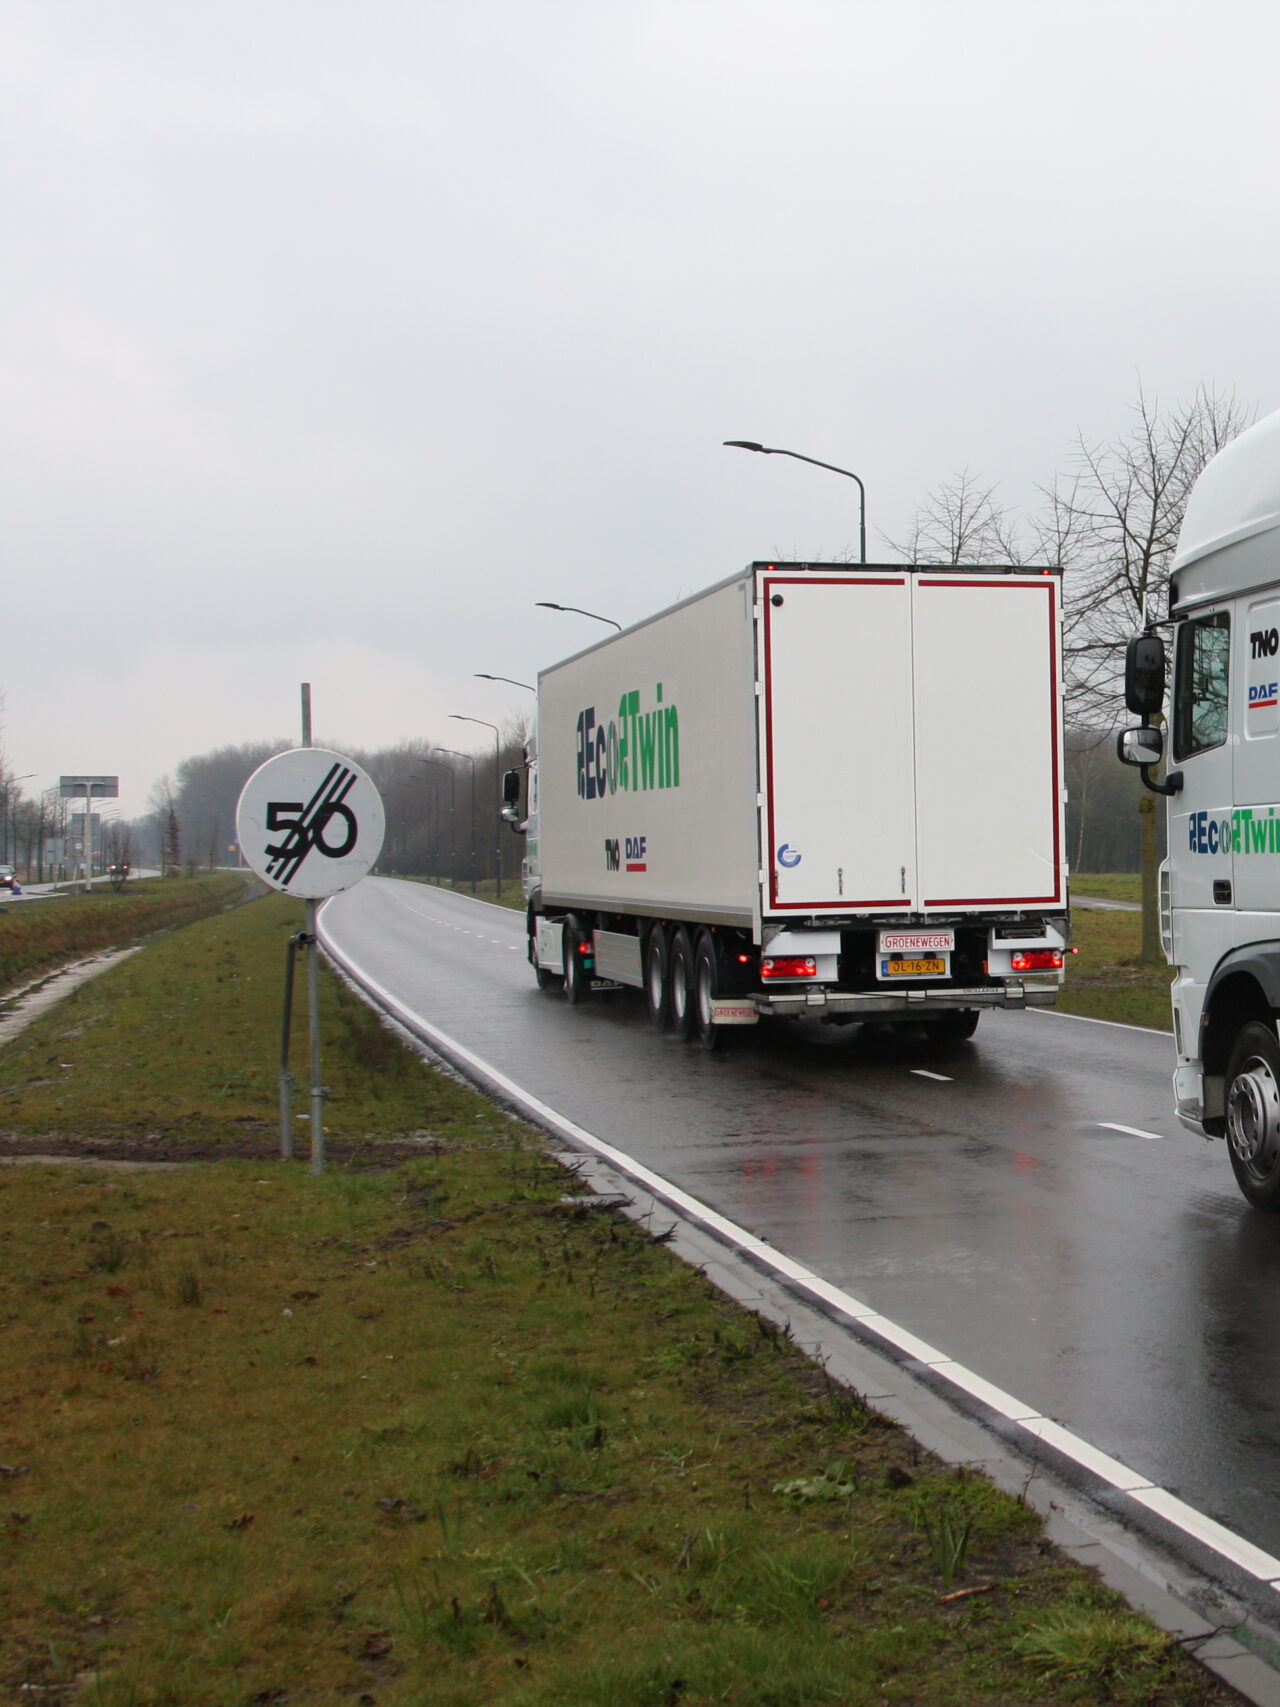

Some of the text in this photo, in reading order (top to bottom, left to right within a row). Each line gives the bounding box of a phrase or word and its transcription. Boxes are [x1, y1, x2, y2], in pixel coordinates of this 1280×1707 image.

[1250, 628, 1279, 660] TNO
[1249, 682, 1279, 700] DAF
[266, 801, 358, 858] 50
[605, 836, 647, 872] TNO DAF
[885, 933, 951, 949] GROENEWEGEN
